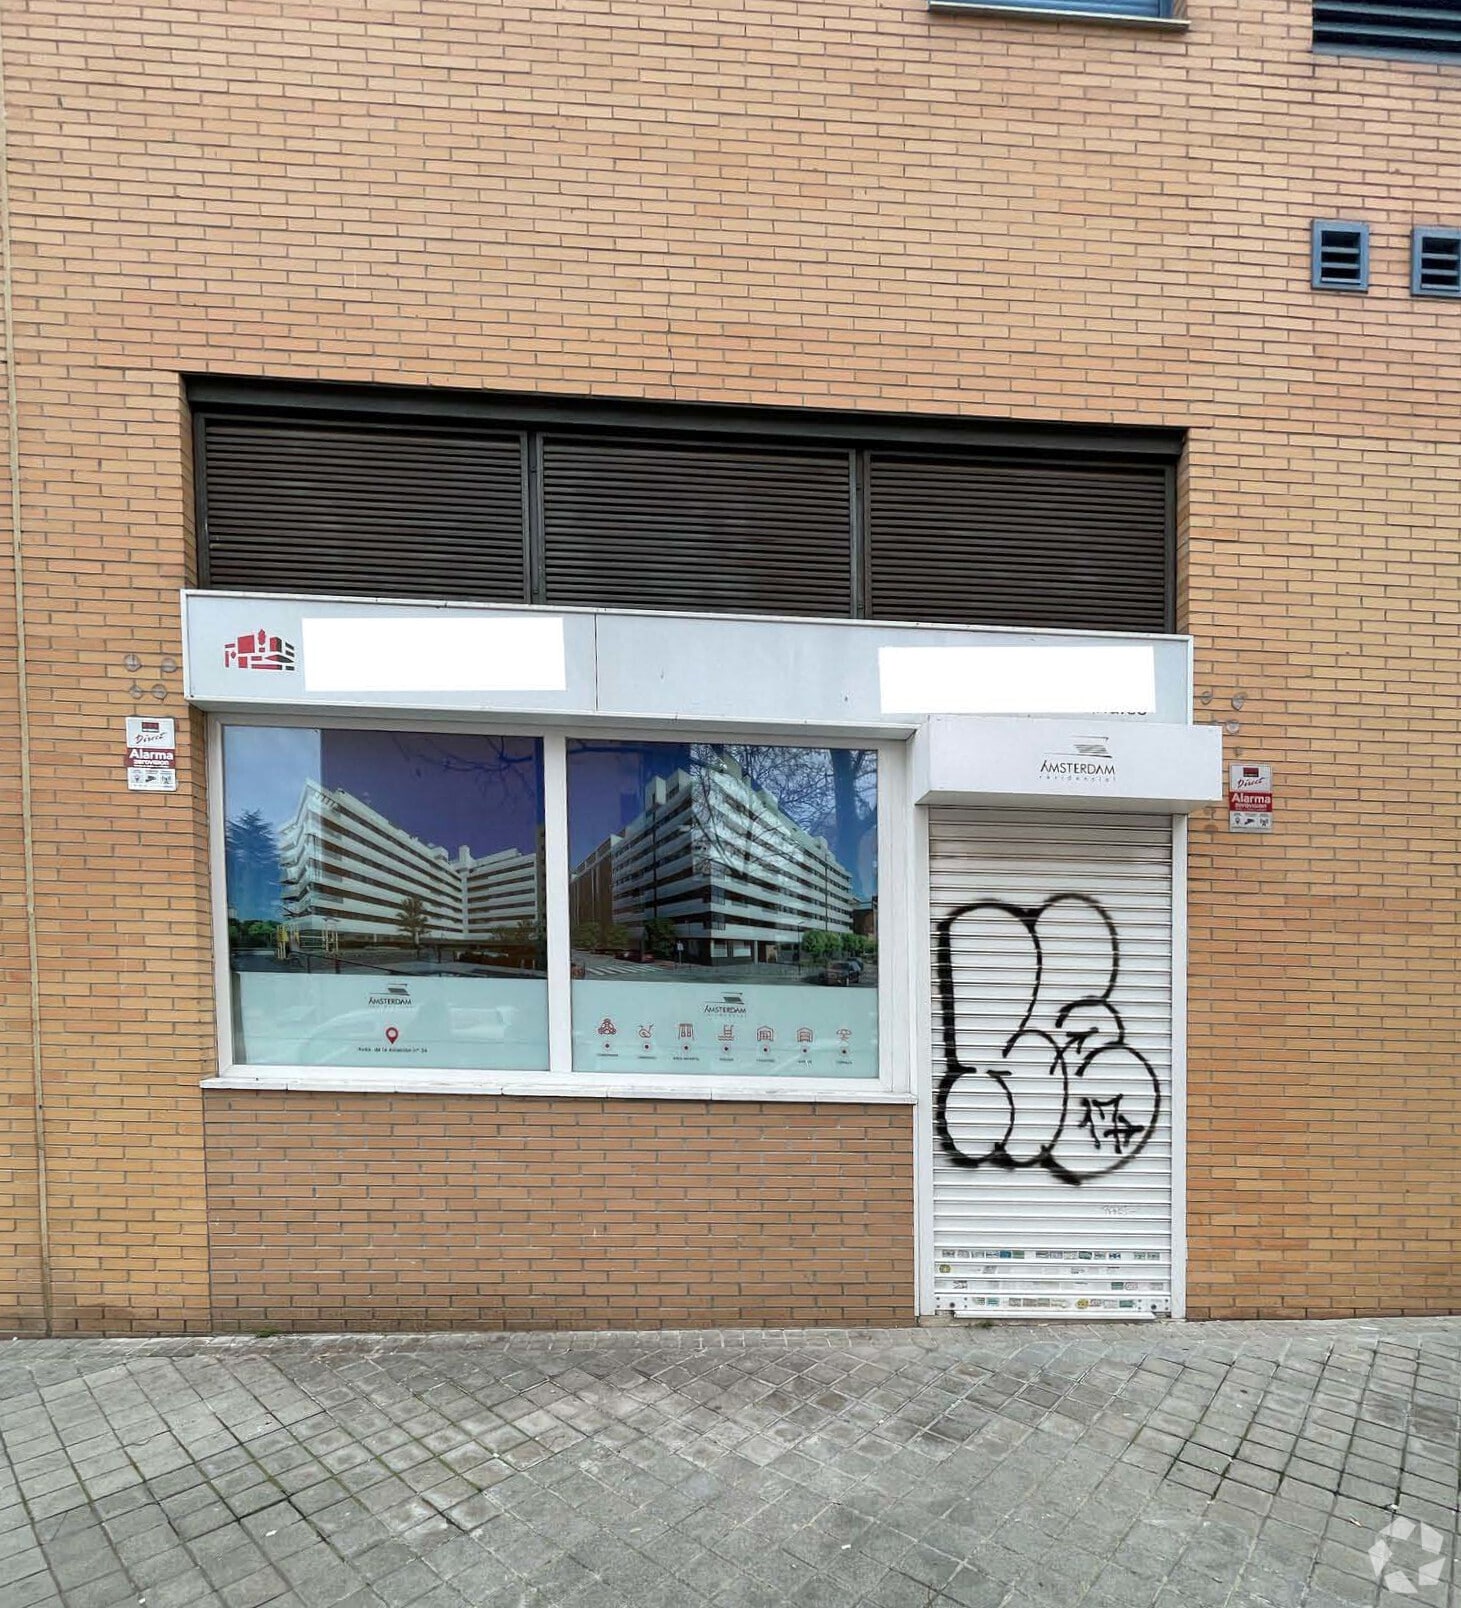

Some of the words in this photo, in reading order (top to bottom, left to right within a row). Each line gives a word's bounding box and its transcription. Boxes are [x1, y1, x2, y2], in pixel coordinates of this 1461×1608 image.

[135, 732, 166, 744] Direct
[129, 749, 173, 760] Alarma
[1237, 777, 1265, 788] Direct
[1231, 793, 1271, 804] Alarma
